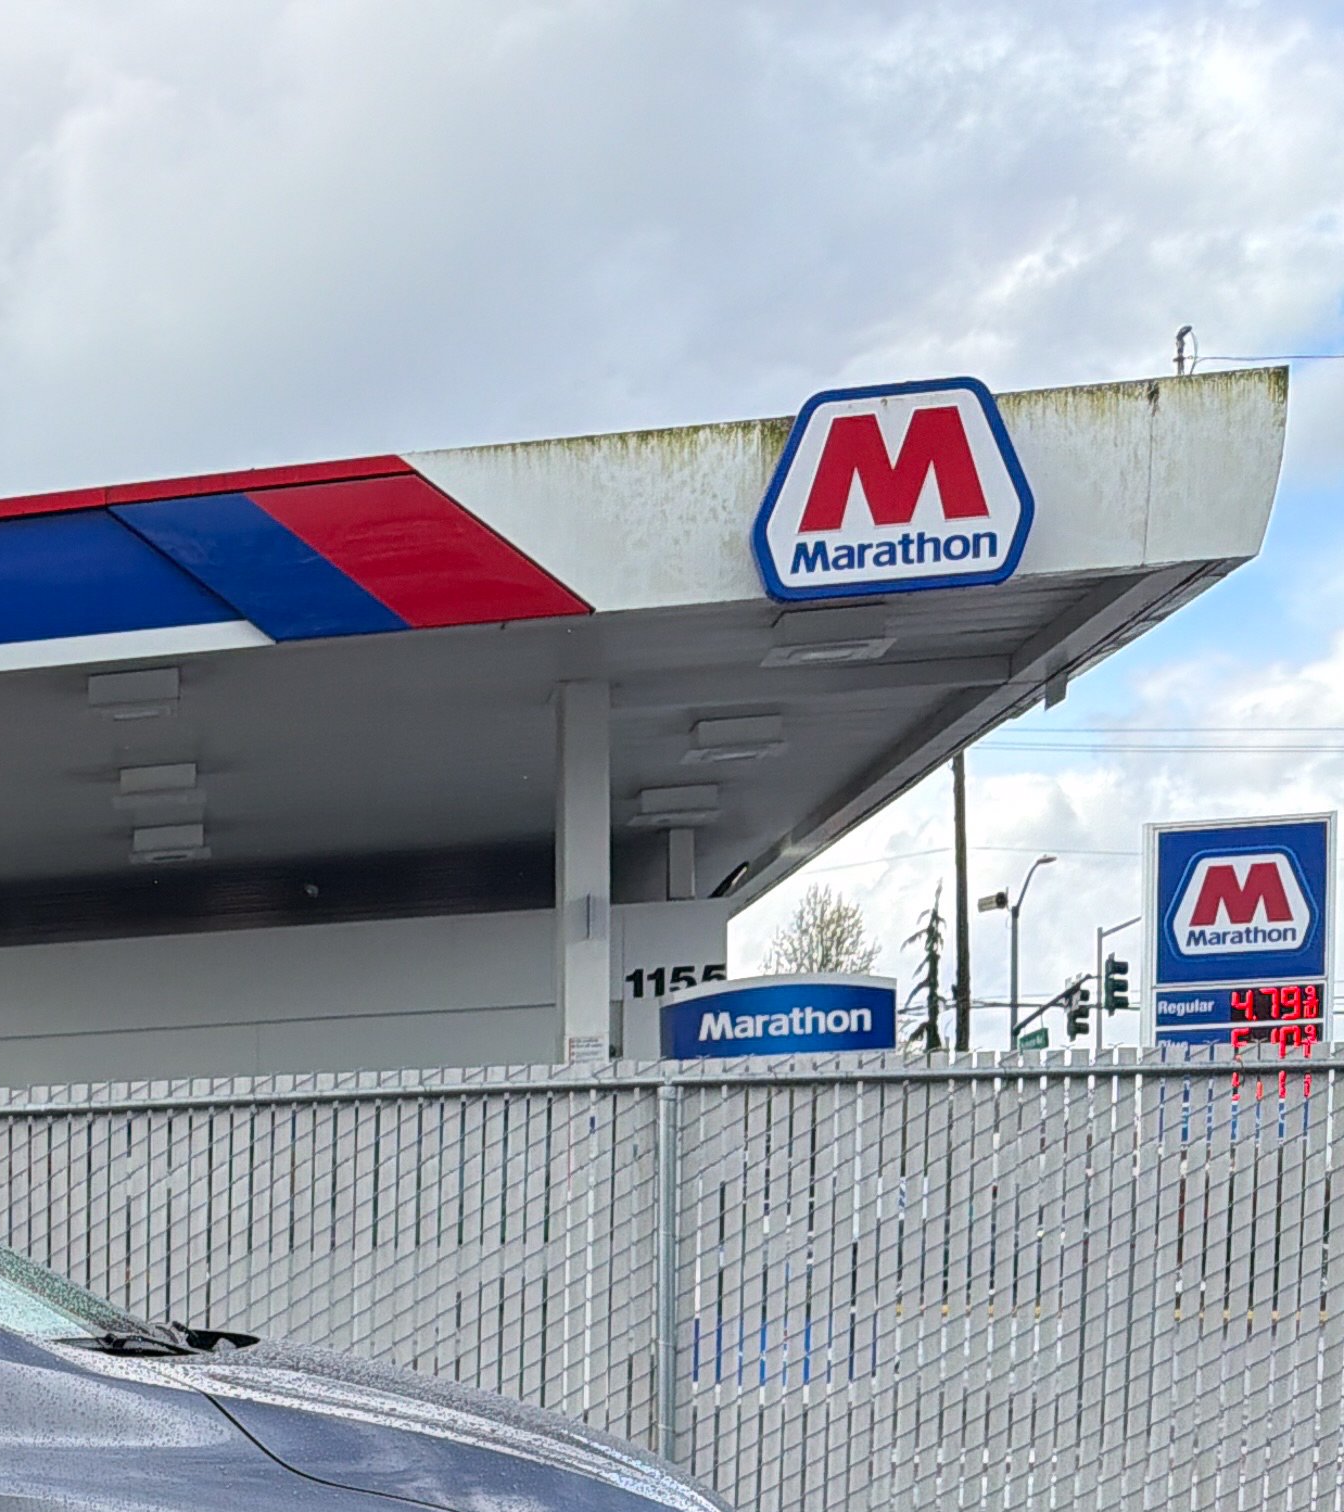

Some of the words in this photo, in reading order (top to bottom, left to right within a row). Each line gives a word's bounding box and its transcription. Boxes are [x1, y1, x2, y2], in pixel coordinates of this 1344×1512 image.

[790, 531, 998, 575] Marathon
[1185, 926, 1297, 947] Marathon
[1158, 998, 1215, 1017] Regular
[698, 1006, 873, 1042] Marathon
